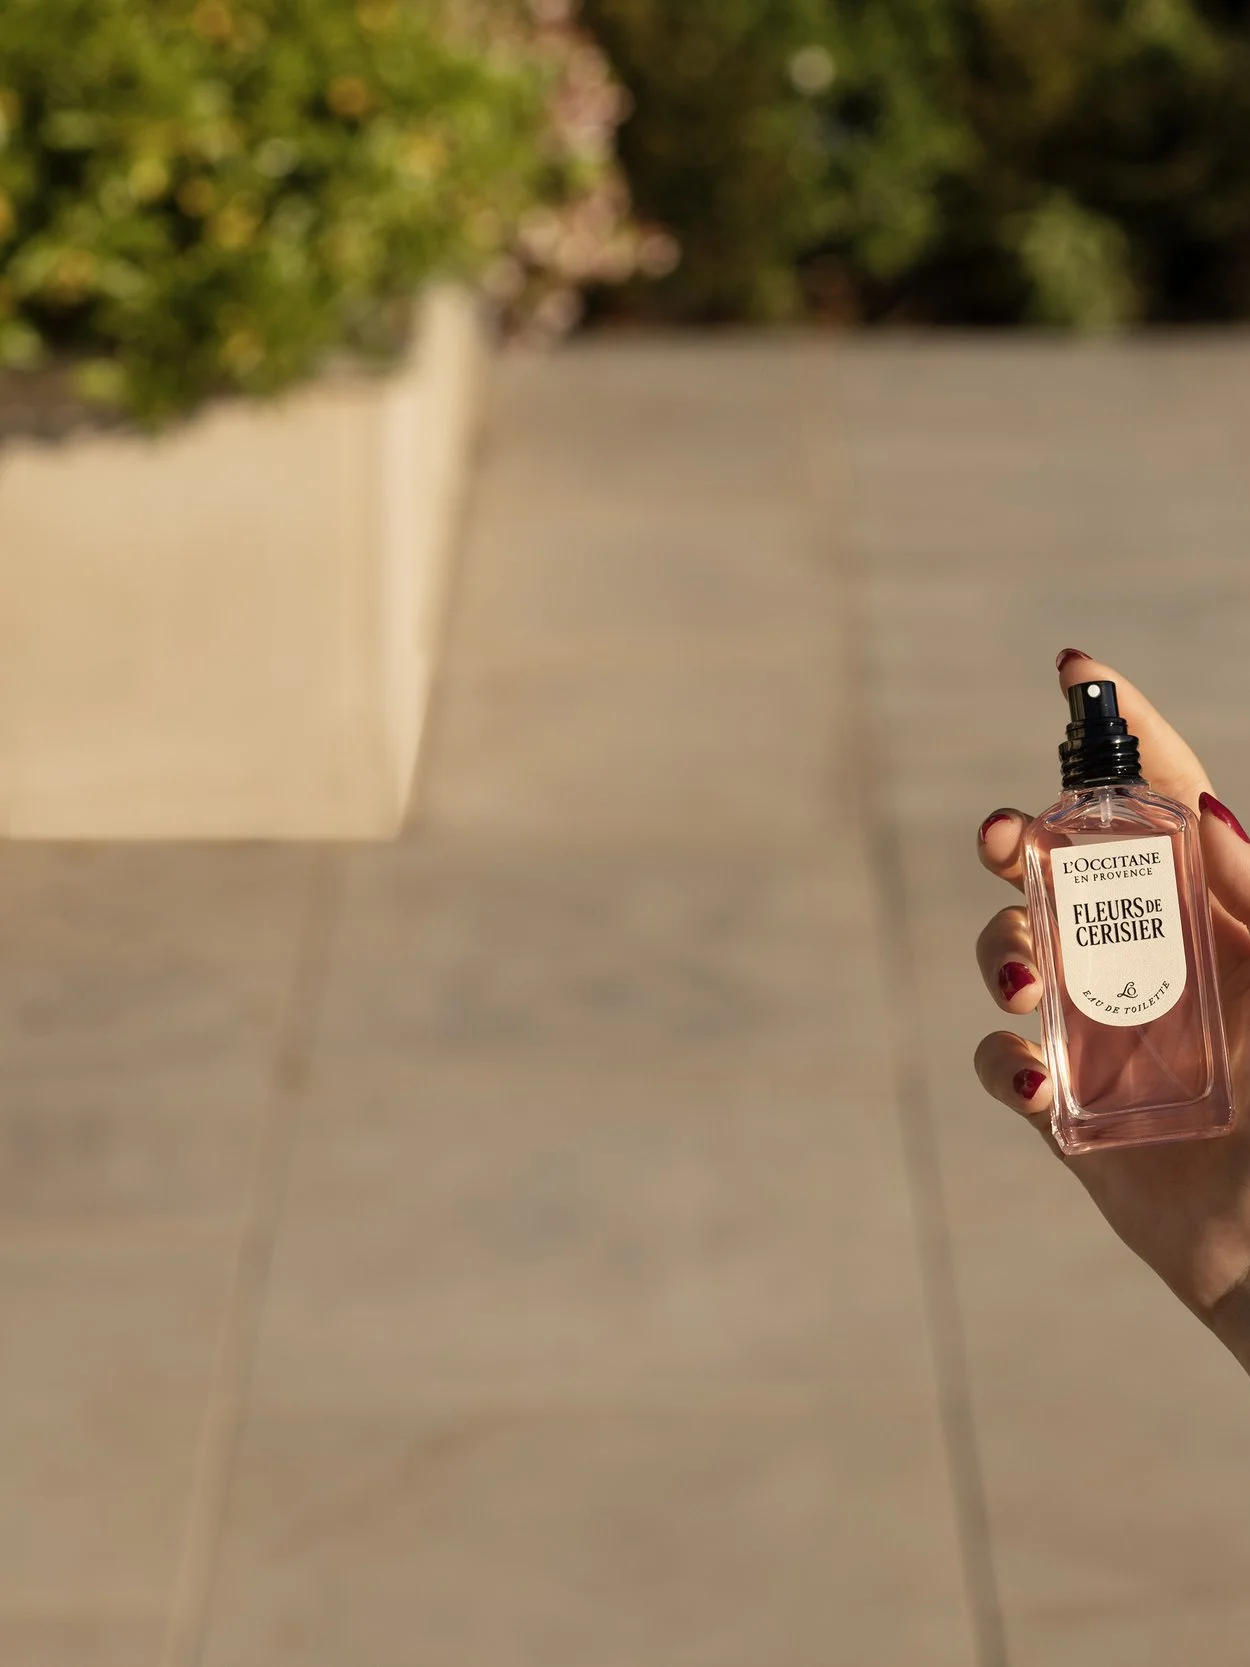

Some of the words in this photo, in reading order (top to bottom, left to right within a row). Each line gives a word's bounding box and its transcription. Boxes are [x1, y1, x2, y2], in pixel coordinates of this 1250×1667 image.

[1063, 852, 1161, 874] L'OCCITANE
[1074, 874, 1089, 883] EN
[1093, 867, 1153, 882] PROVENCE
[1072, 897, 1144, 925] FLEURS
[1146, 898, 1163, 914] DE
[1076, 918, 1165, 947] CERISIER
[1082, 989, 1103, 1007] EAU
[1105, 1006, 1119, 1014] DE
[1124, 980, 1170, 1014] TOILETTE
